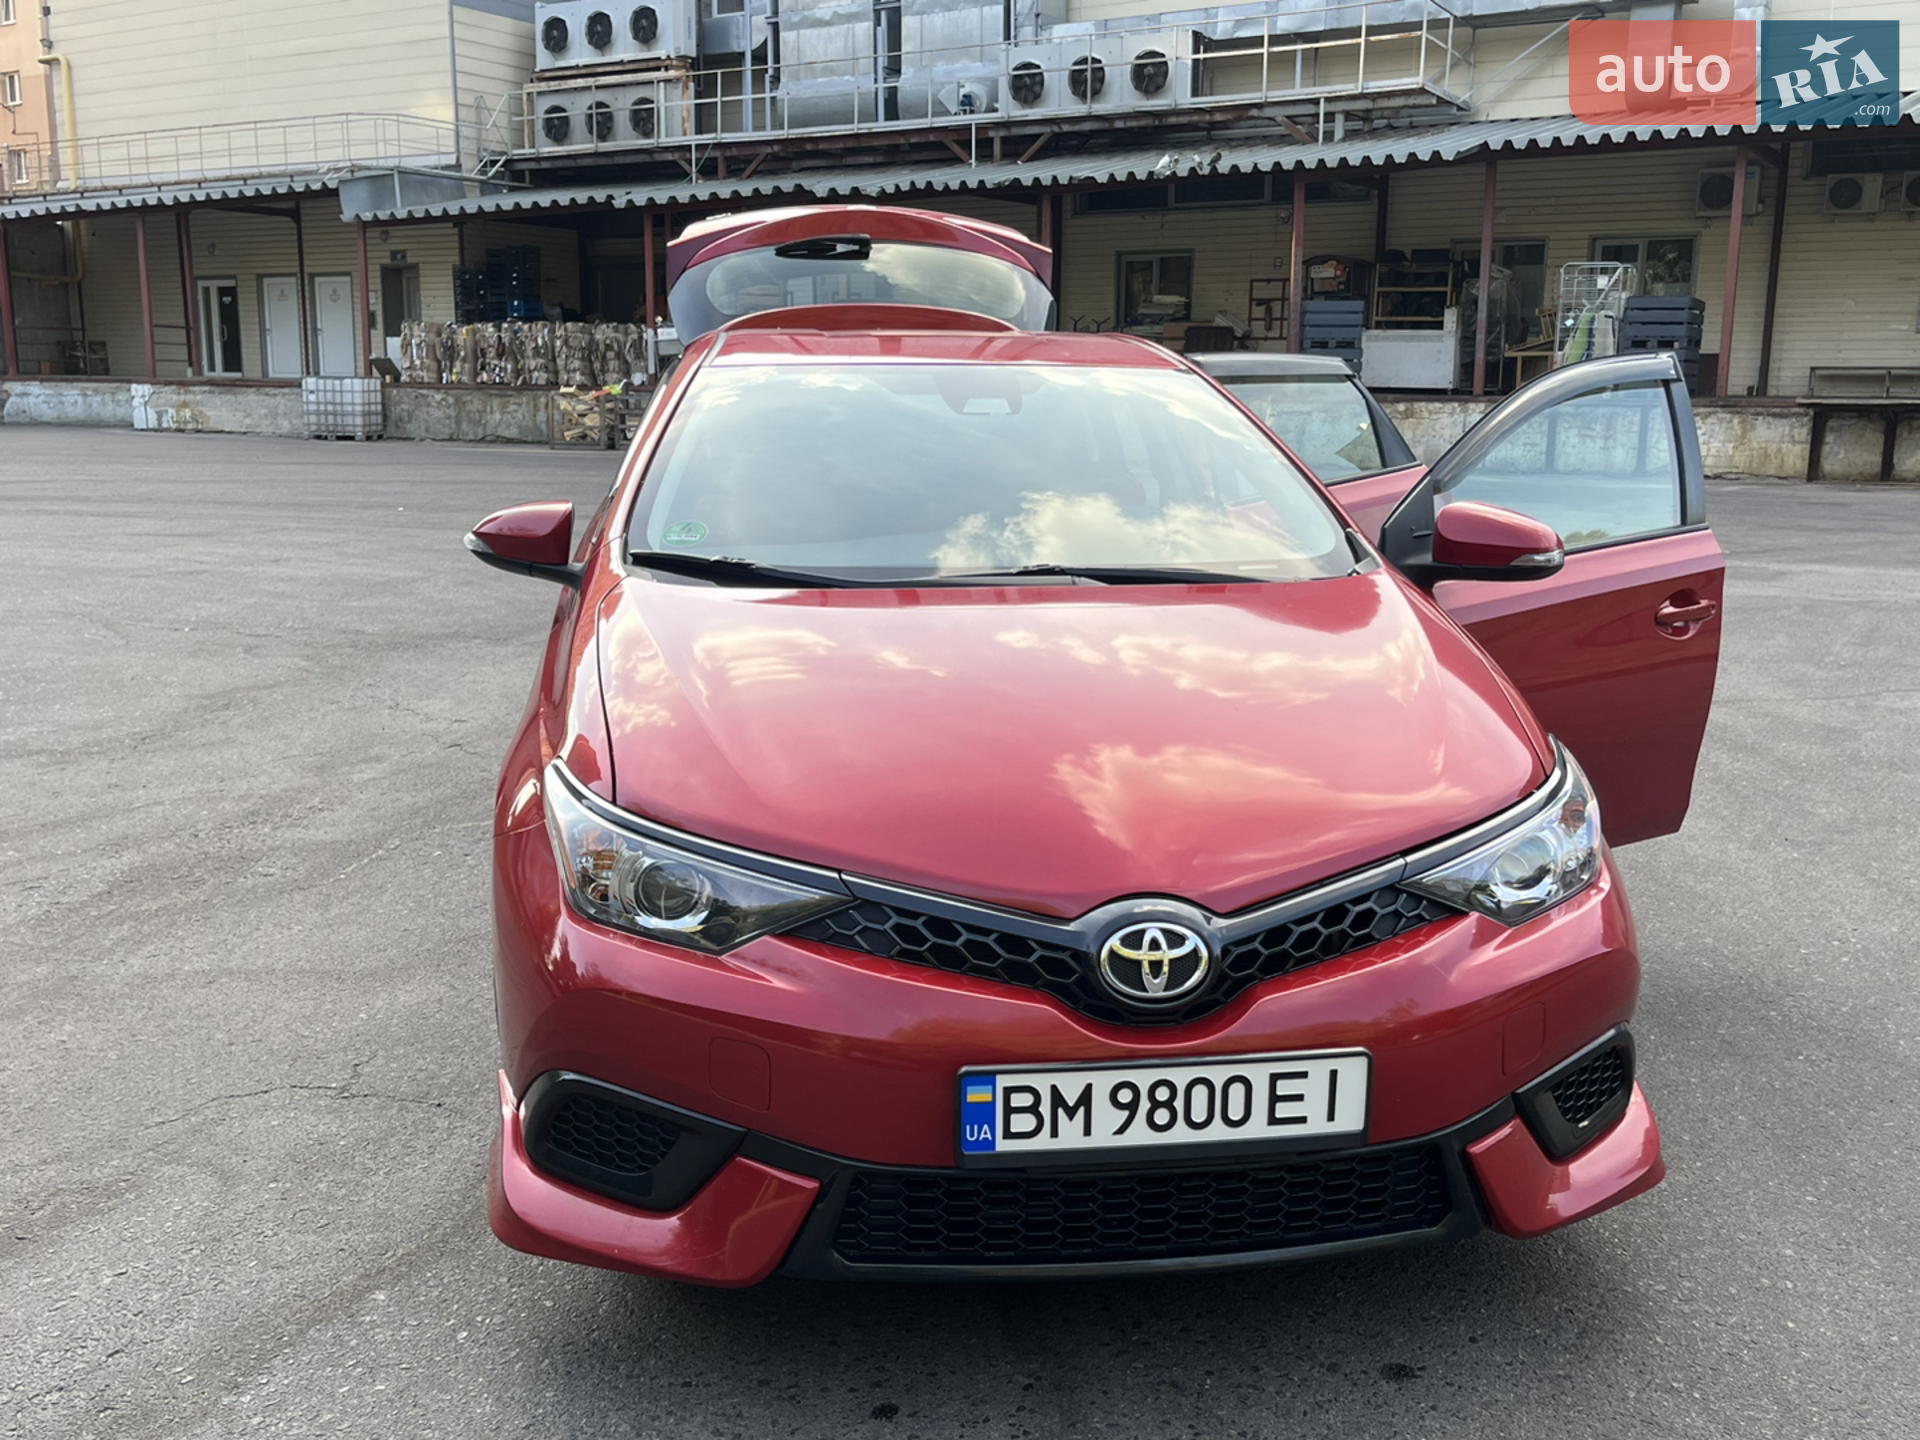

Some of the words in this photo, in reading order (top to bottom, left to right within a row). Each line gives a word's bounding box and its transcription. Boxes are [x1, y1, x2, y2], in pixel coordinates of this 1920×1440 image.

[1001, 1082, 1094, 1140] BM
[1108, 1074, 1253, 1136] 9800
[1266, 1068, 1339, 1127] EI
[965, 1123, 993, 1142] UA
